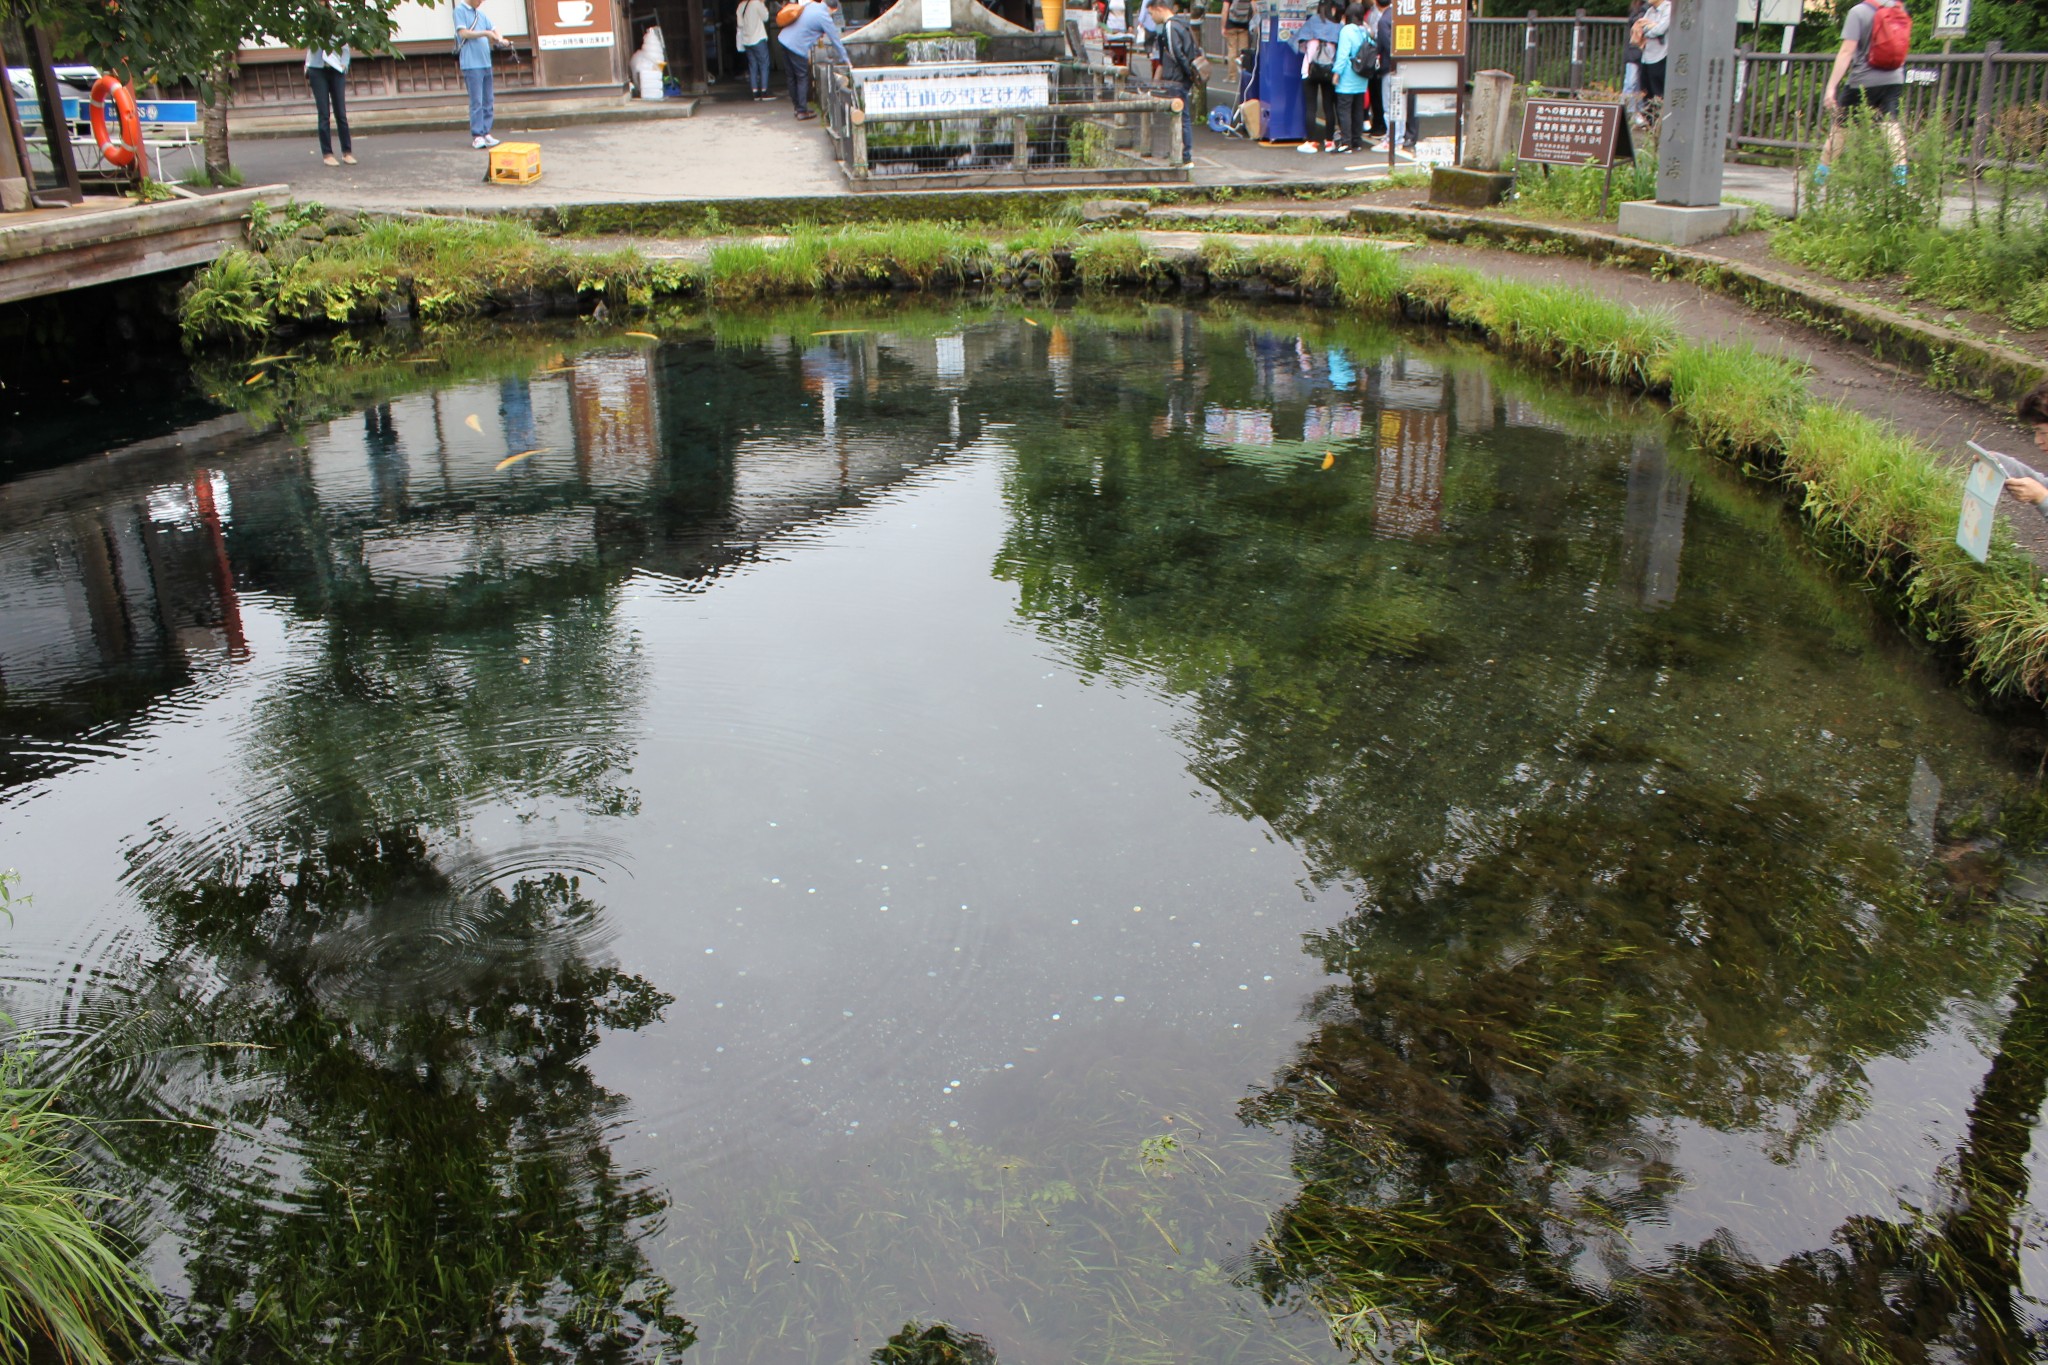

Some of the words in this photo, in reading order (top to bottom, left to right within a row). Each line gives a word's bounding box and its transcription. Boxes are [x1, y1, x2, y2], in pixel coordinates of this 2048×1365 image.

[880, 86, 1034, 109] 富士山の雪どけ水
[1536, 106, 1605, 117] 池への硬貨投入禁止
